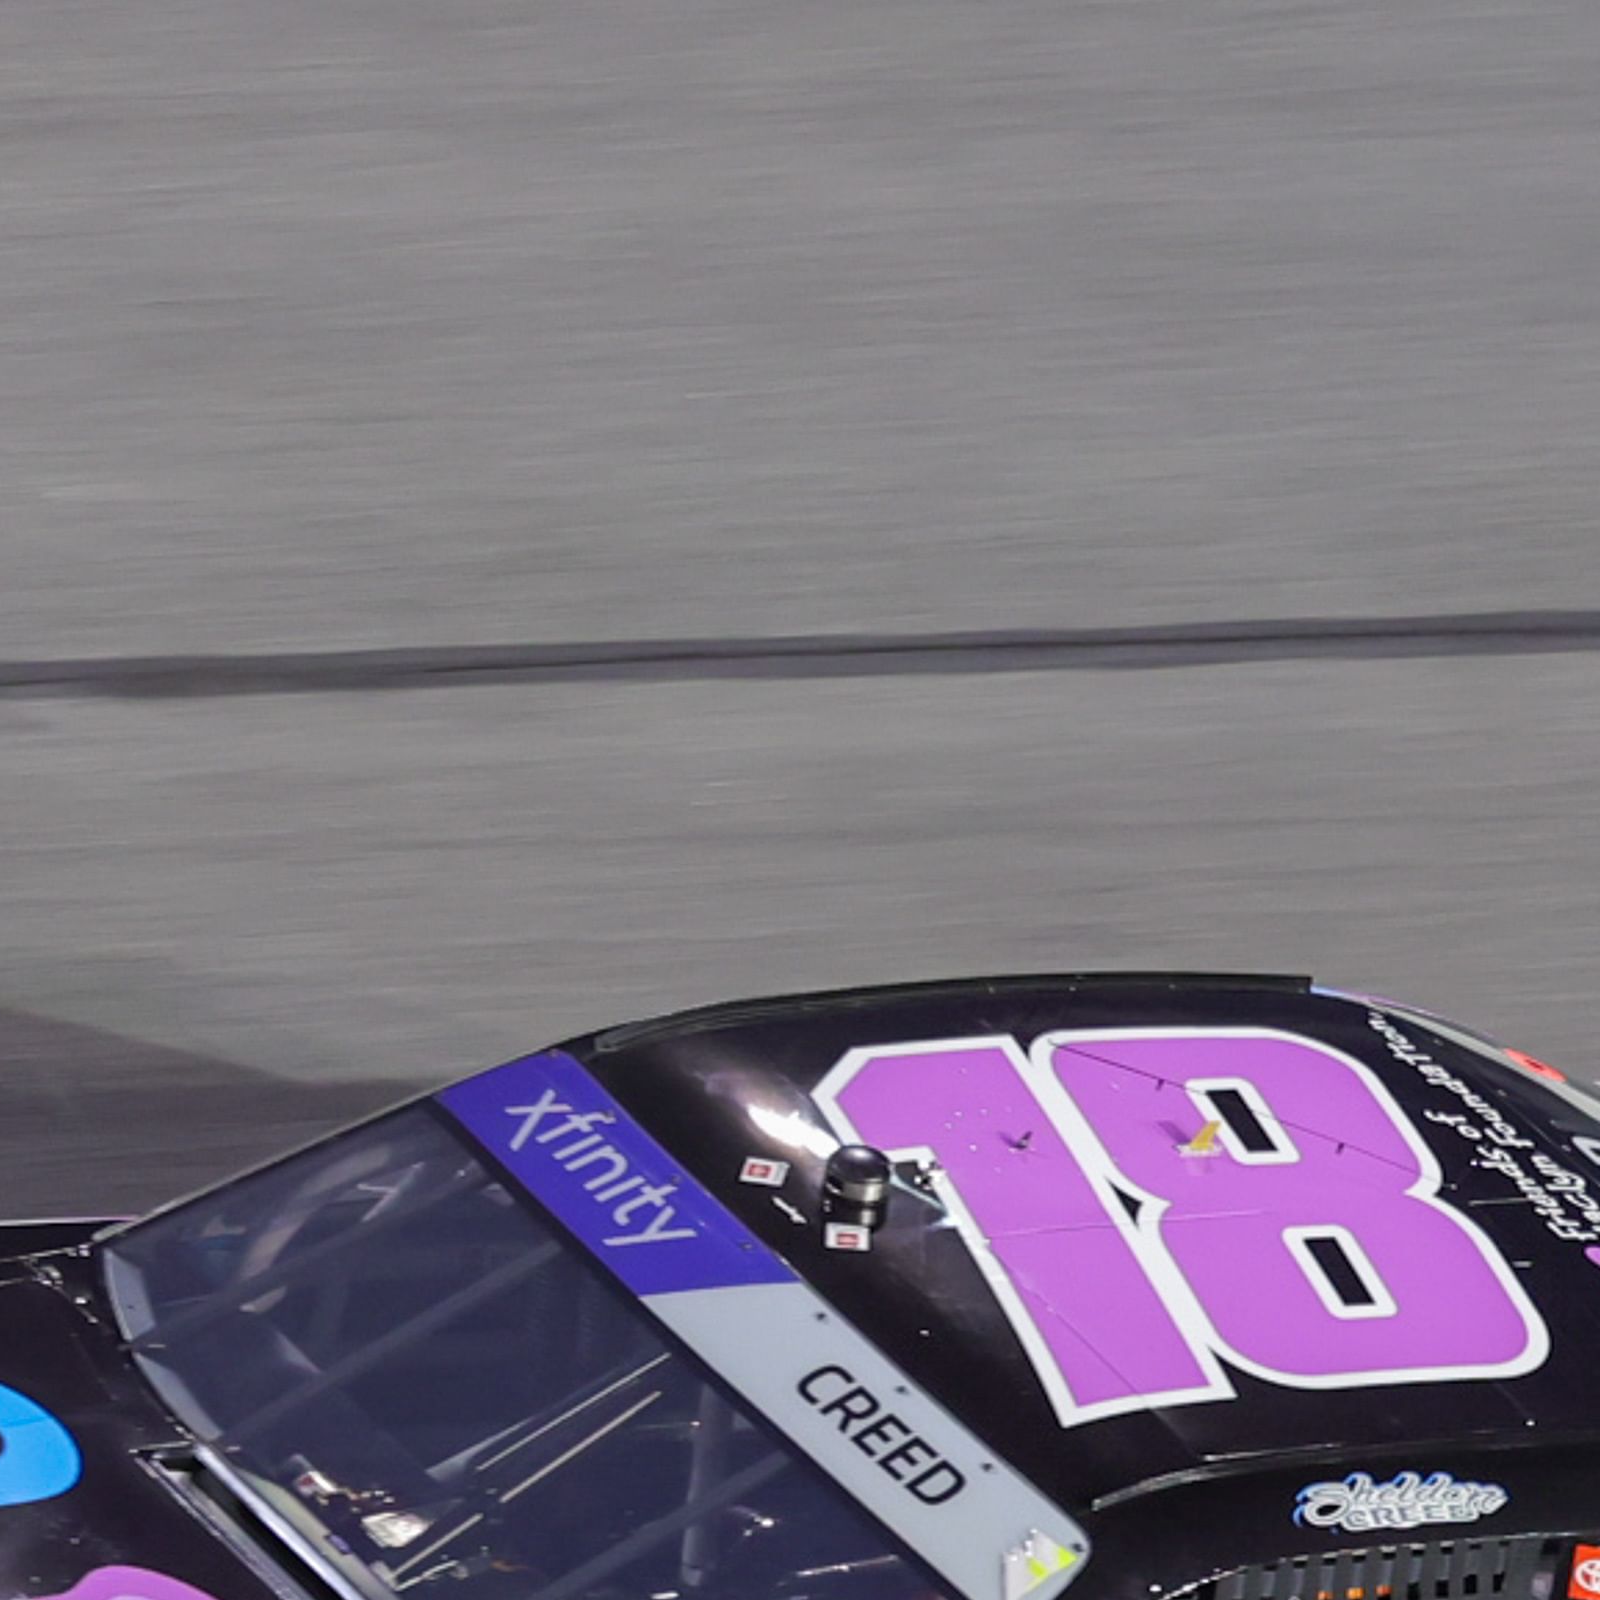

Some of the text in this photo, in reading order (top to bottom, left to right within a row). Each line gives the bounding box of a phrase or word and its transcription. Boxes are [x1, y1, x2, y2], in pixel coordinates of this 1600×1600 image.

[809, 1027, 1551, 1428] 18
[1423, 1109, 1600, 1241] Friends of
[796, 1364, 967, 1507] CREED
